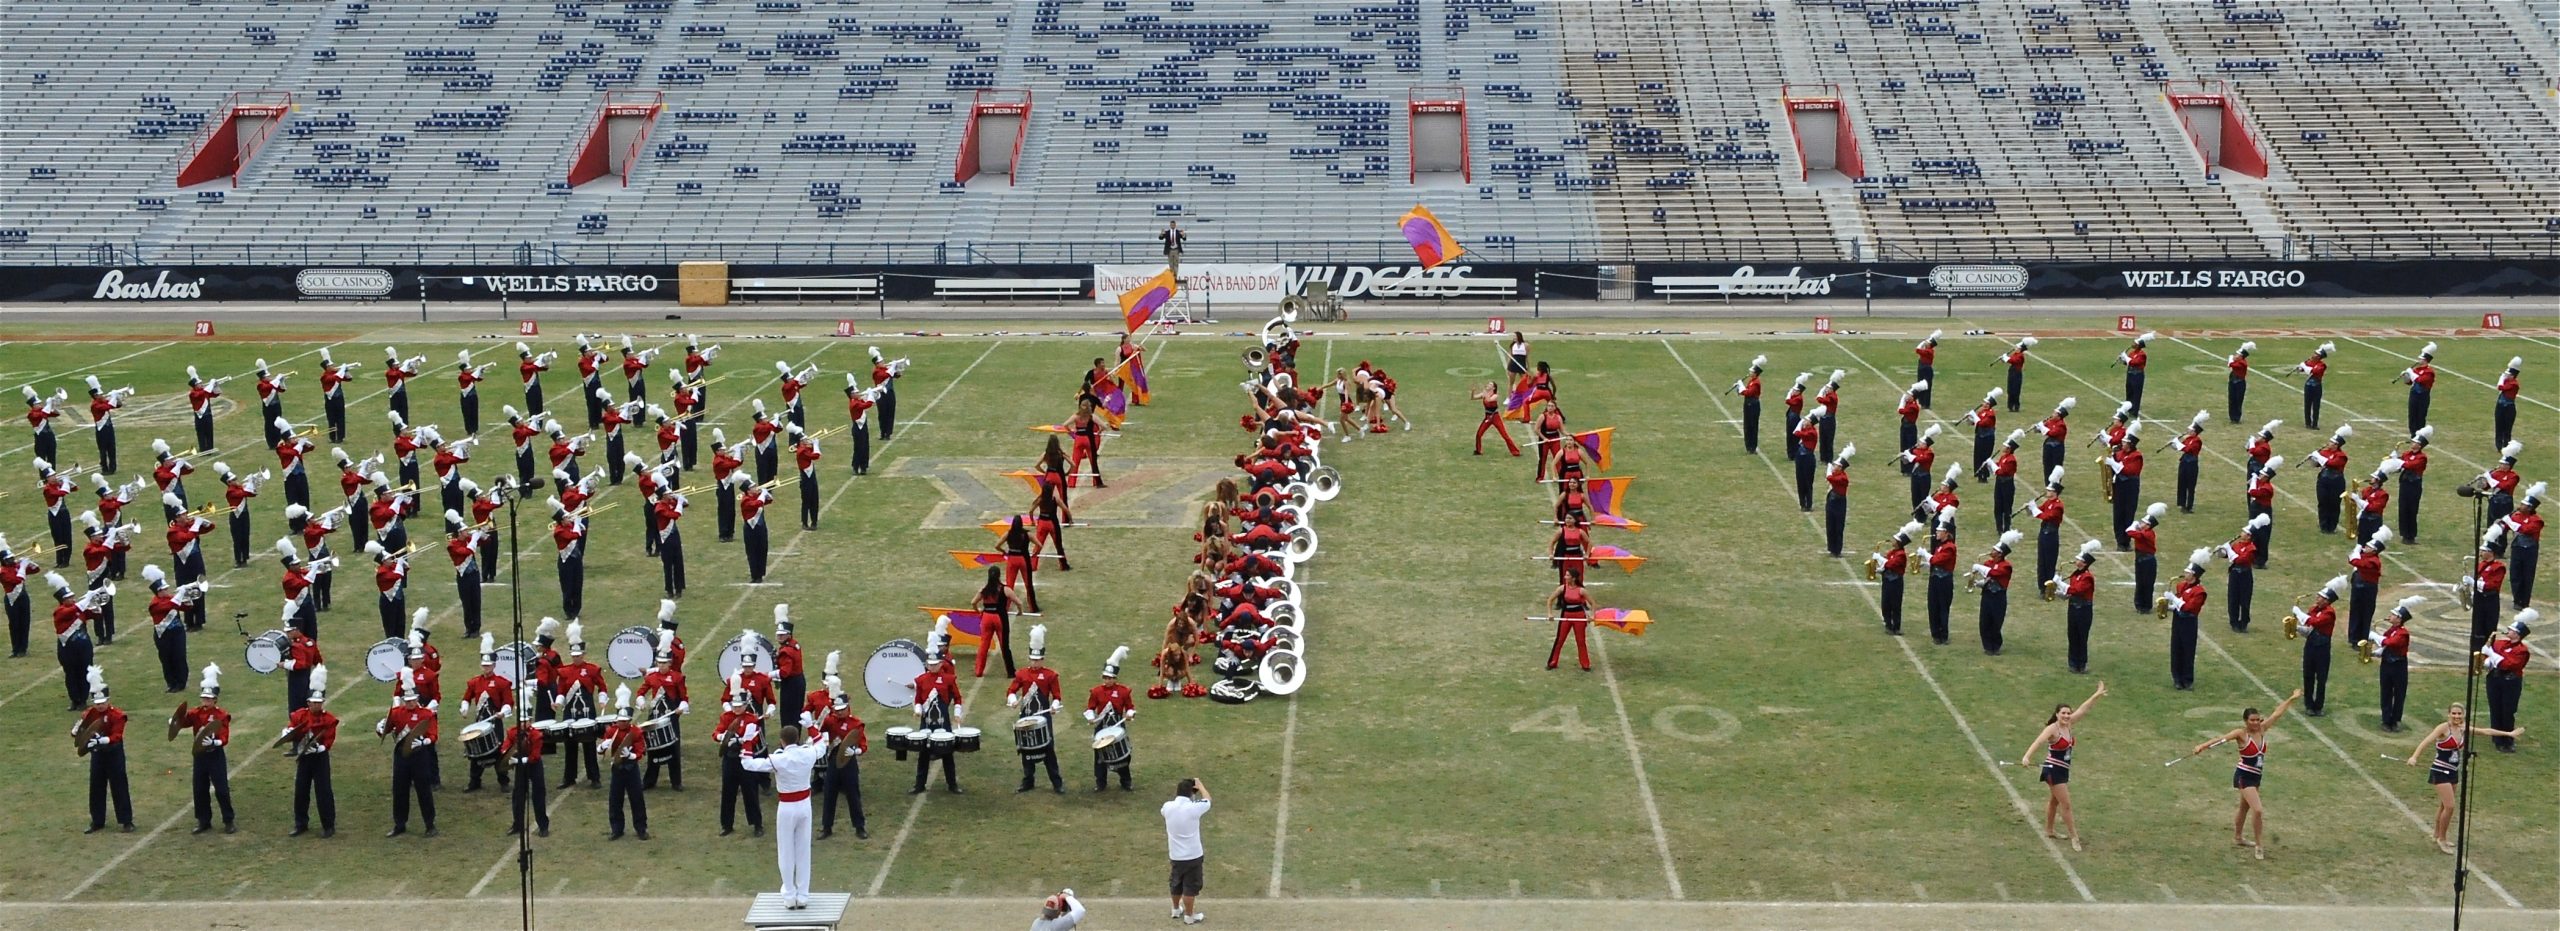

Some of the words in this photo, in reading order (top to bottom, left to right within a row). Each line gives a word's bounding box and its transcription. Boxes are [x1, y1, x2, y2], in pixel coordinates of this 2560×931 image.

[306, 277, 328, 287] SOL
[331, 277, 383, 287] CASINOS
[483, 275, 570, 292] WELLS
[575, 275, 658, 292] FARGO
[1226, 276, 1256, 291] BAND
[1258, 276, 1280, 291] DAY
[1940, 273, 1961, 283] SOL
[1965, 273, 2018, 283] CASINOS
[2122, 270, 2212, 288] WELLS
[2218, 270, 2305, 288] FARGO
[93, 269, 205, 300] Bashas'
[521, 321, 533, 333] 30
[1489, 319, 1501, 331] 40
[1816, 319, 1829, 330] 30
[2121, 317, 2134, 329] 20
[2488, 315, 2500, 327] 10
[196, 322, 209, 334] 20
